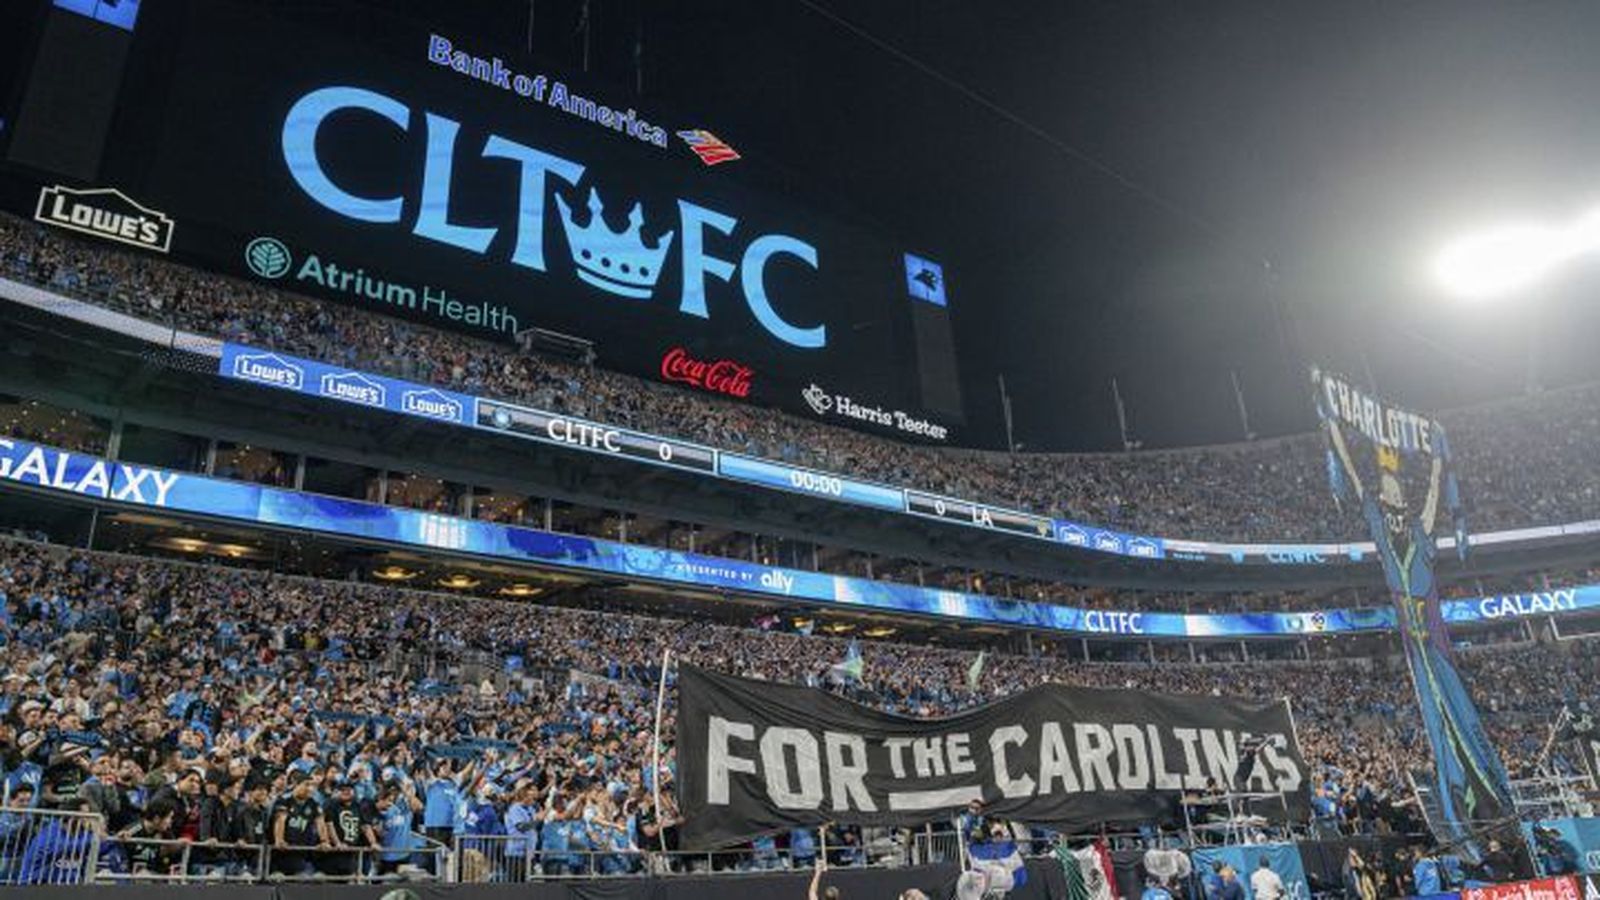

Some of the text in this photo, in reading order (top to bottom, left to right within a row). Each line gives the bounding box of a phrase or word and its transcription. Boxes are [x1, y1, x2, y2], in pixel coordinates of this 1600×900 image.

[429, 34, 668, 149] Bank of America
[297, 255, 518, 335] Atrium Health
[834, 395, 948, 441] Harris Teeter
[1325, 376, 1431, 454] CHARLOTTE
[547, 419, 673, 462] CLTFC 0
[790, 470, 842, 497] 00:00
[935, 500, 994, 529] 0 LA
[761, 568, 794, 596] ally
[1480, 589, 1577, 618] GALAXY
[1085, 610, 1143, 635] CLTFC
[707, 715, 1301, 813] FOR THE CAROLINAS
